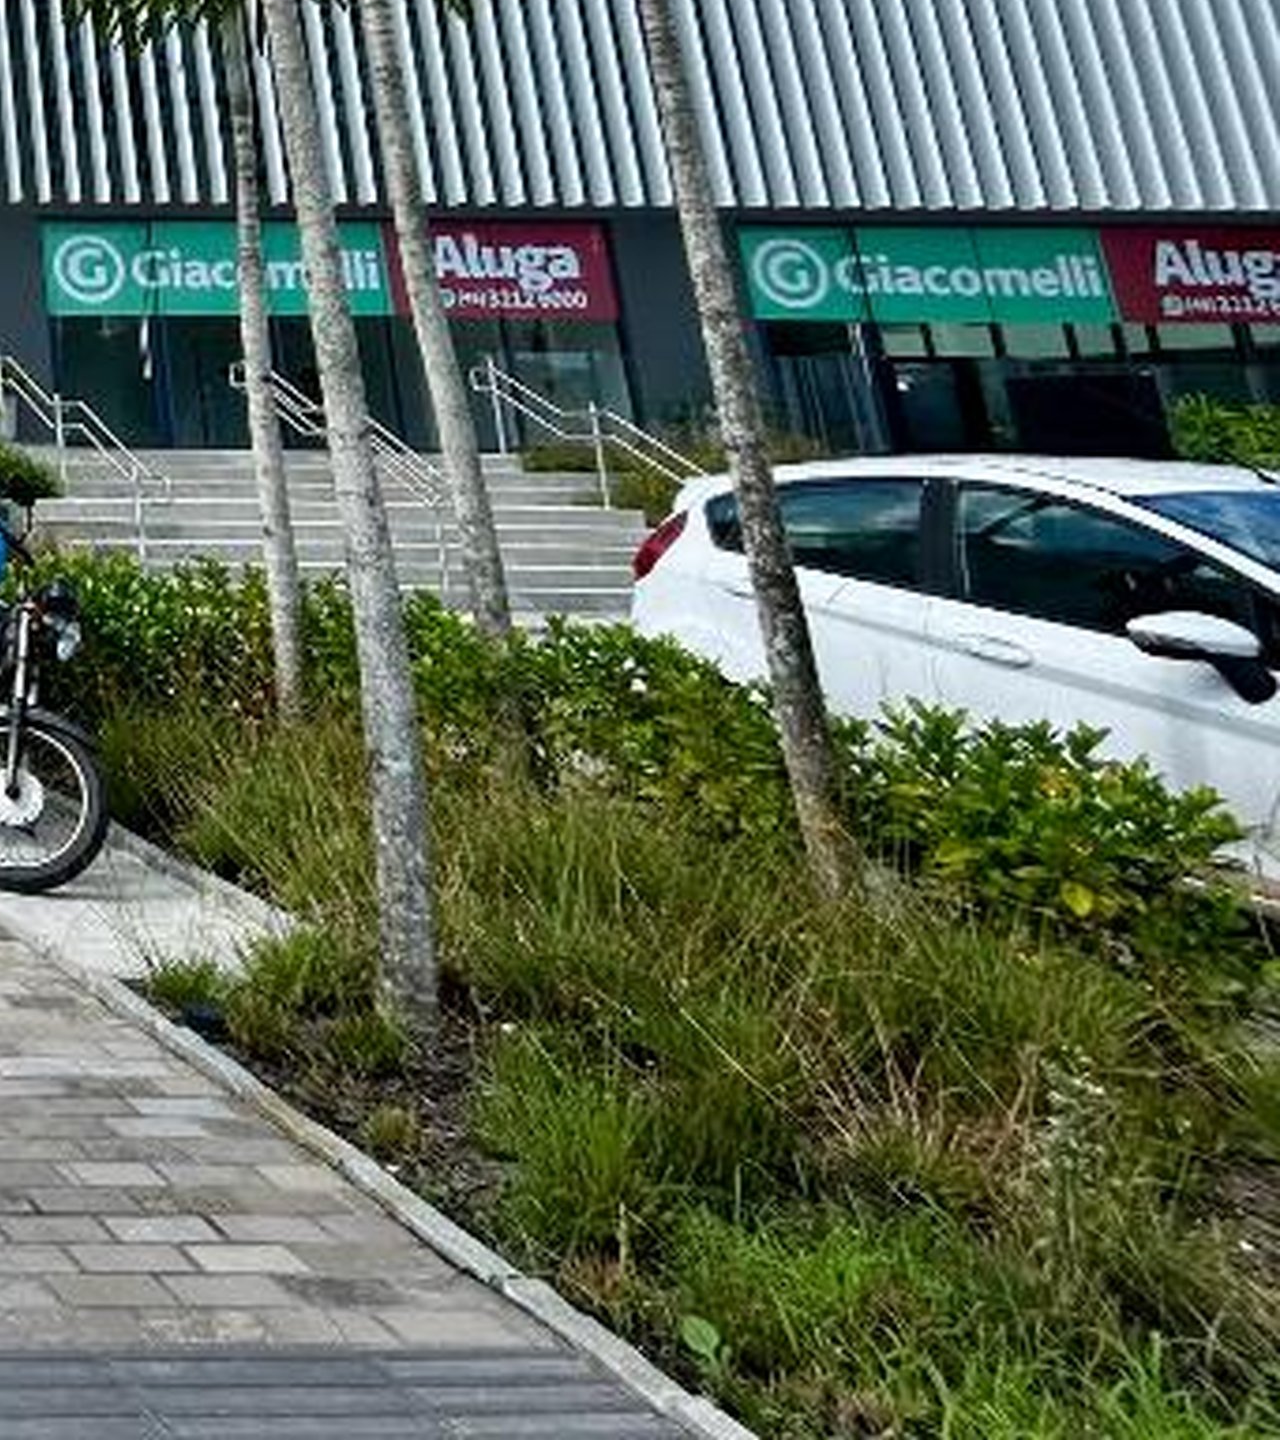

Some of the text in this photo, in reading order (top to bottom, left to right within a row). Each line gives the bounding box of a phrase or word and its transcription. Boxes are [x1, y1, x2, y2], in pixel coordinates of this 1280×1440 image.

[132, 247, 380, 289] Giacmlli
[435, 234, 580, 292] Aluga
[834, 254, 1102, 297] Giacomelli
[1155, 239, 1280, 298] Alug
